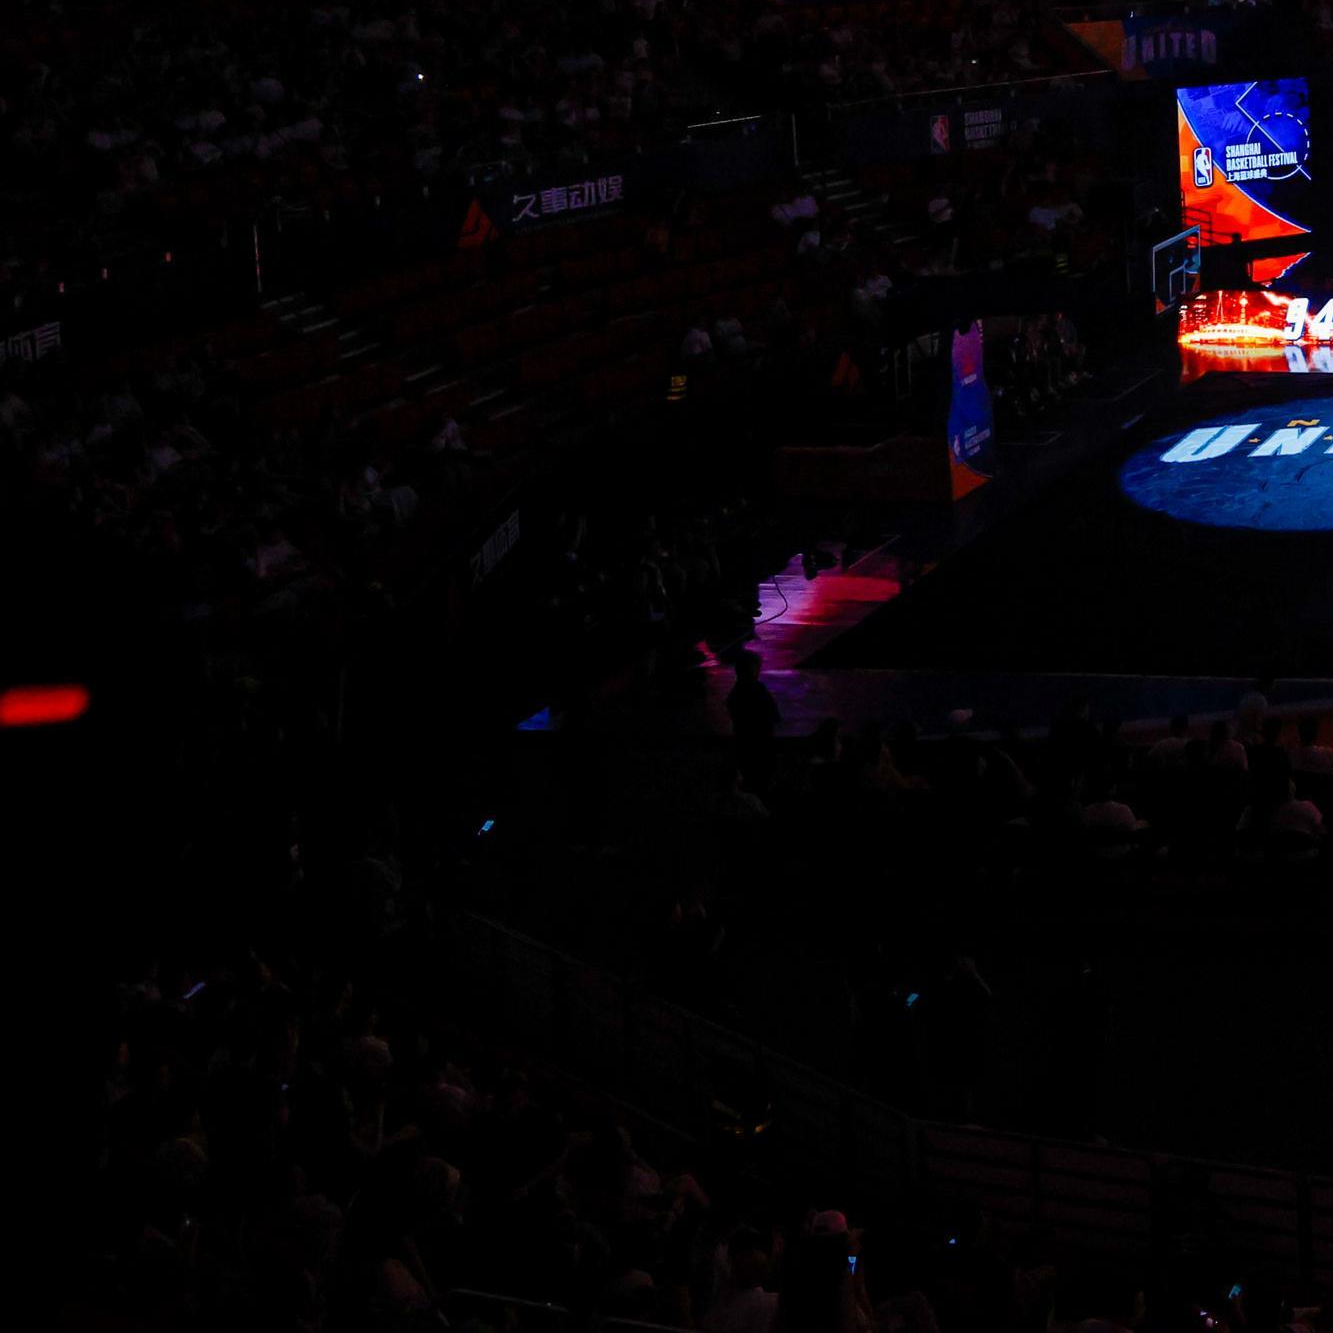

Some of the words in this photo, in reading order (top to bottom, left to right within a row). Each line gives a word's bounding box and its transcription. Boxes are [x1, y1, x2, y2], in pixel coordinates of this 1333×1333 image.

[1226, 142, 1261, 158] SHANGHAI
[1226, 155, 1268, 171] BASKETBALL
[1268, 152, 1298, 167] FESTIVAL
